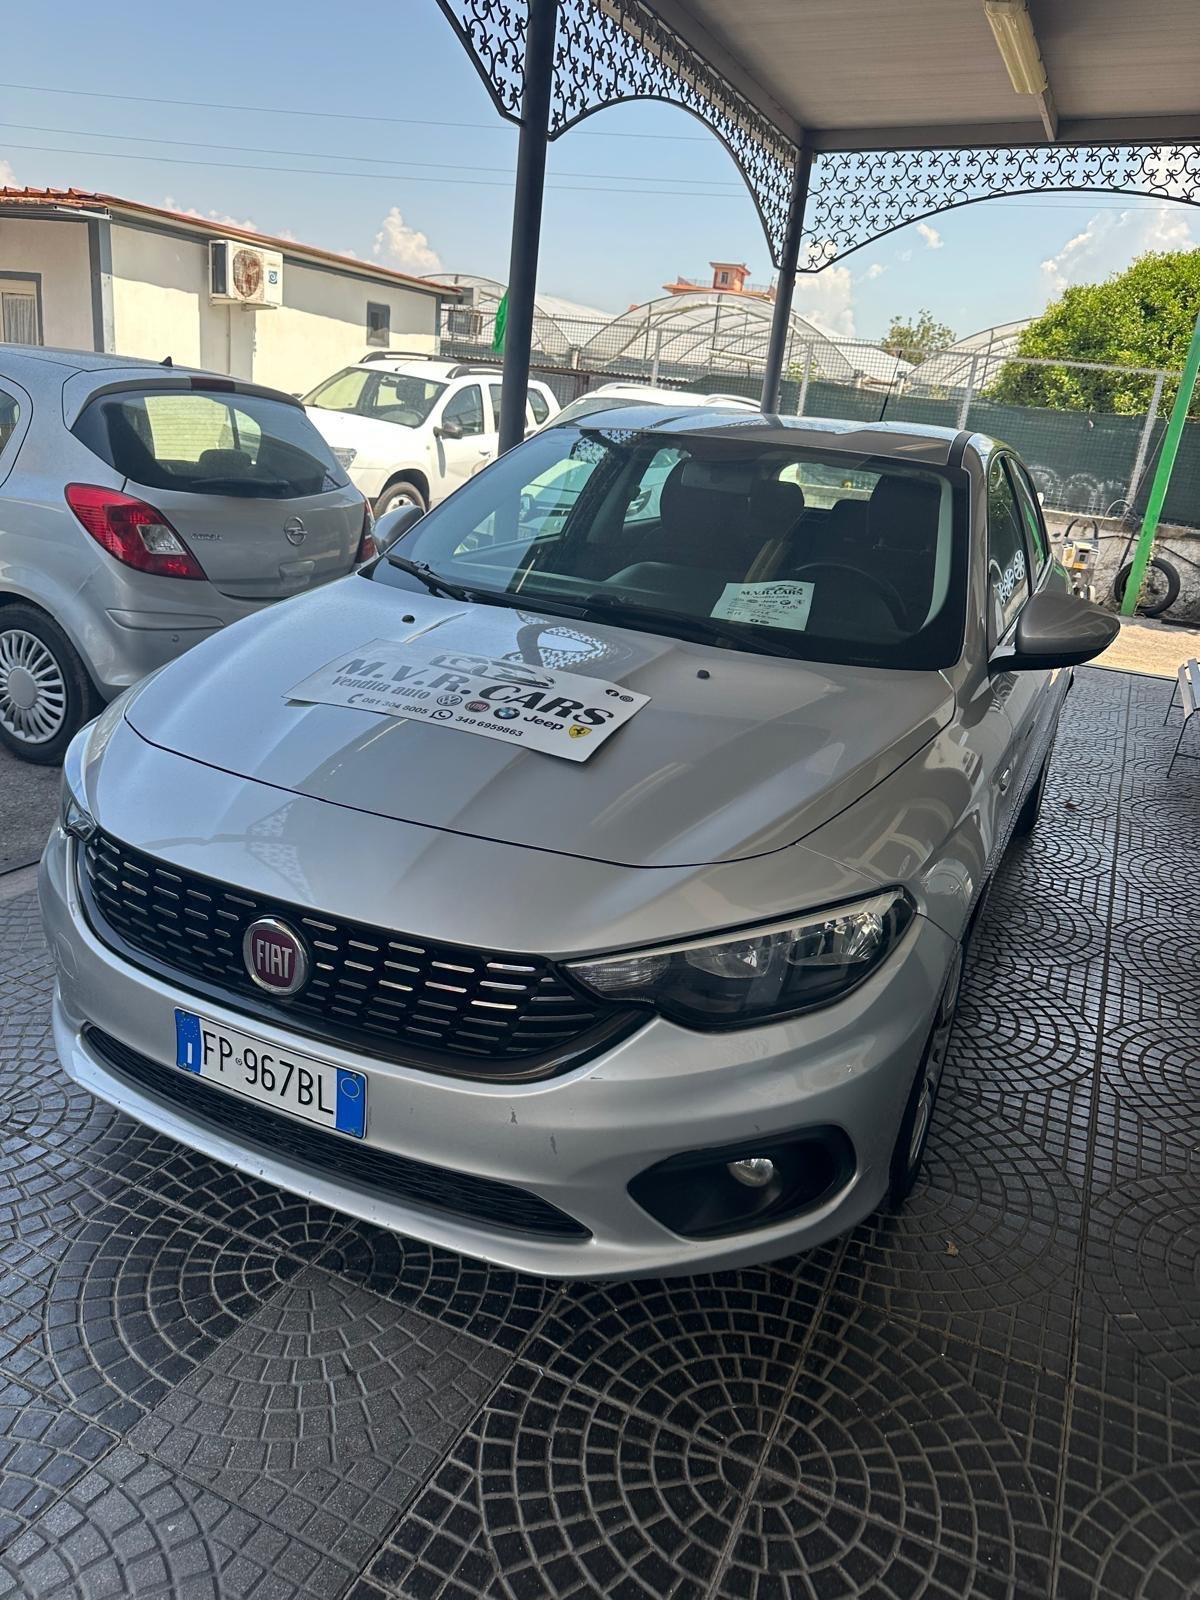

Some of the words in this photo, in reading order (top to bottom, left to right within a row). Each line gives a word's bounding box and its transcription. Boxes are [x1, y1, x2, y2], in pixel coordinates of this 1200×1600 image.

[331, 676, 392, 693] Vendita
[391, 685, 432, 700] auto
[455, 716, 477, 725] 349
[523, 715, 564, 731] Jeep
[256, 939, 293, 979] FIAT
